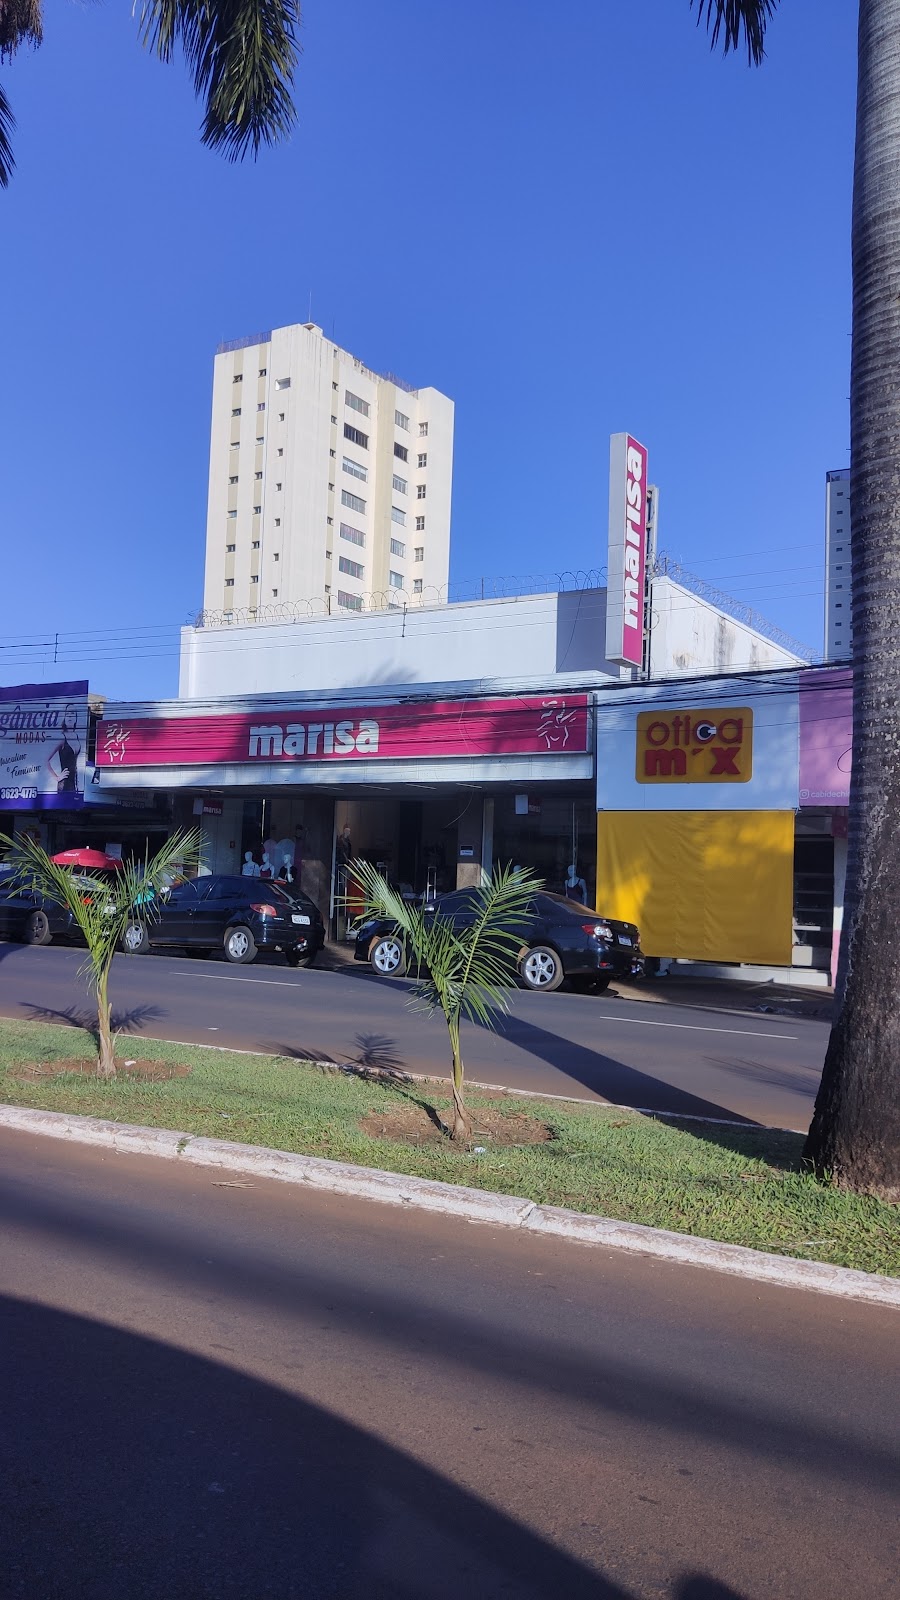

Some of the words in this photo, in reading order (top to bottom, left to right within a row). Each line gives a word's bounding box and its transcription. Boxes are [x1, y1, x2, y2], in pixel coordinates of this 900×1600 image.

[624, 445, 643, 630] marisa
[15, 731, 46, 745] MODAS
[248, 720, 380, 757] marisa
[644, 747, 741, 776] mx
[0, 787, 38, 800] 3623-4775
